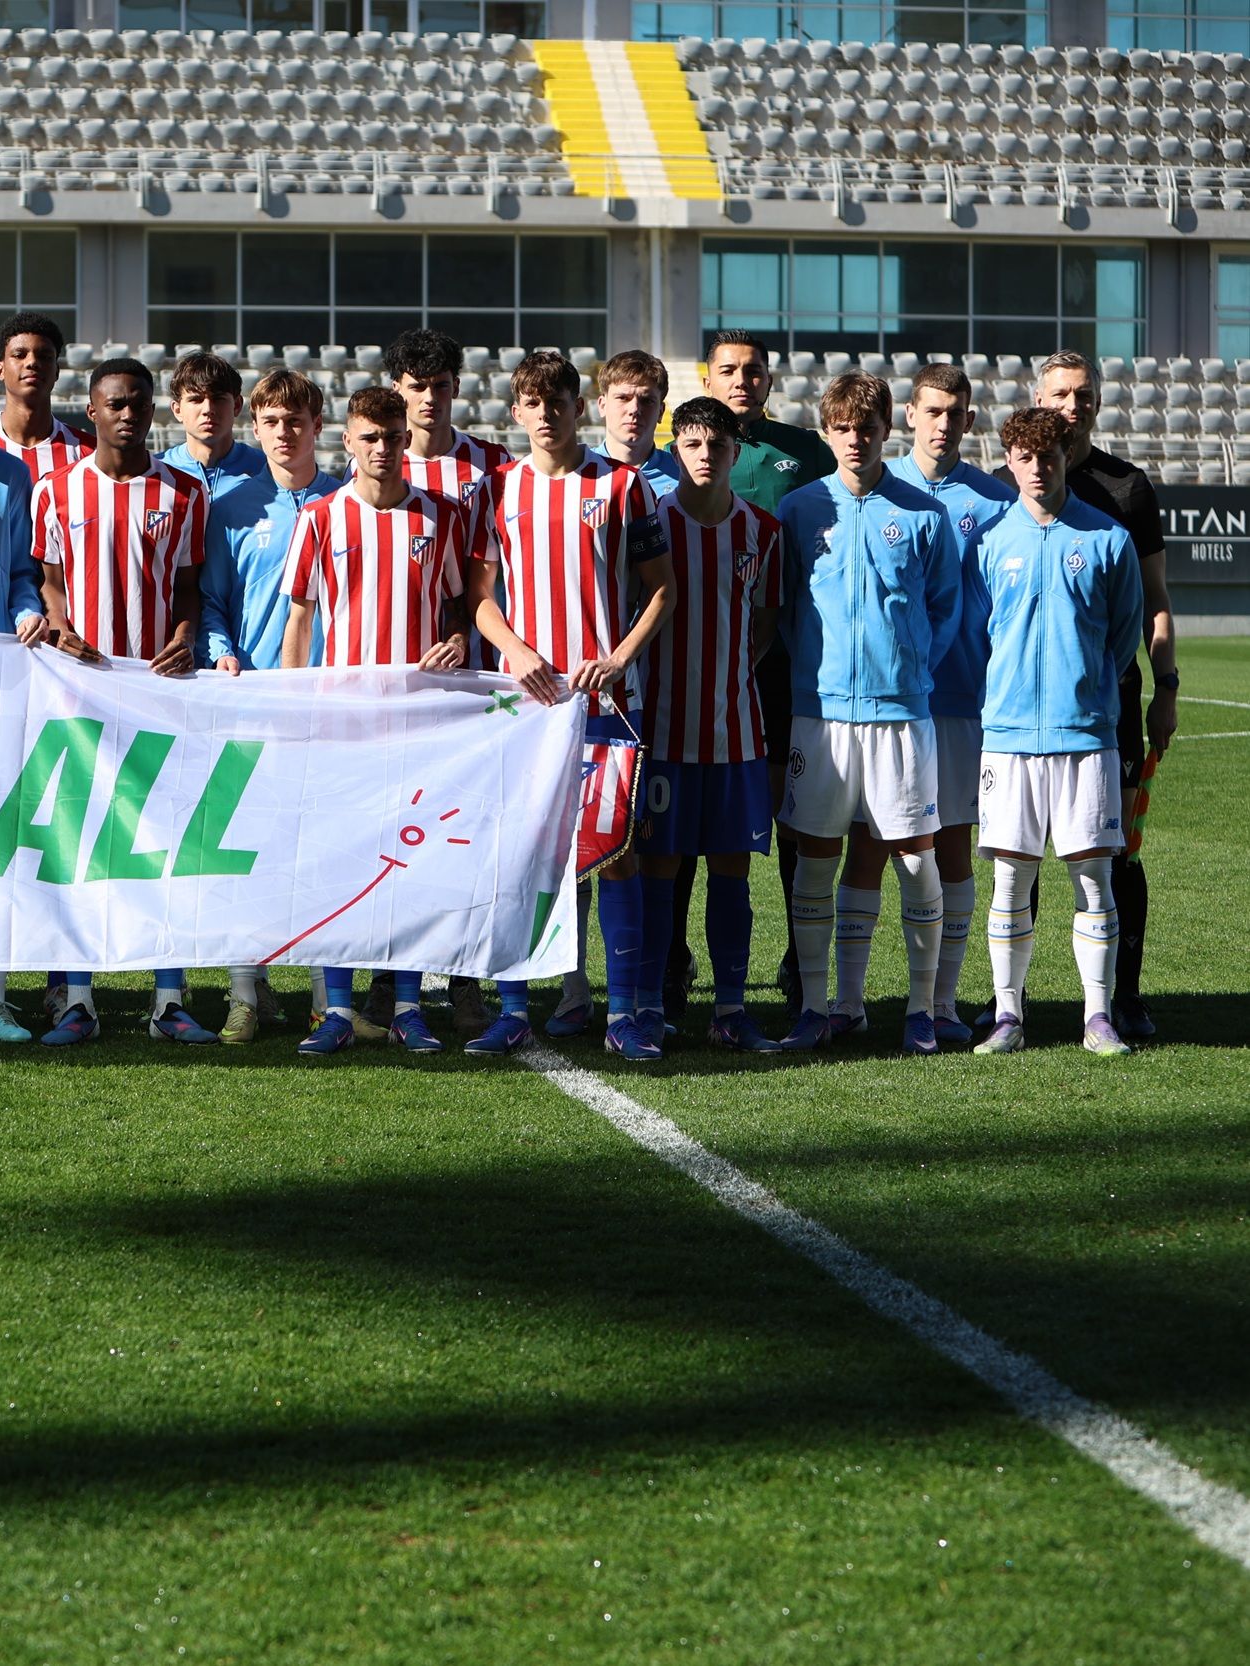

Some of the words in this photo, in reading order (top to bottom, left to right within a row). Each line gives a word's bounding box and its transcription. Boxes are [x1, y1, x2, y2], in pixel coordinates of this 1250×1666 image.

[775, 460, 799, 472] UEFA
[257, 533, 271, 549] 17
[1191, 543, 1234, 562] HOTELS
[1009, 572, 1018, 588] 7
